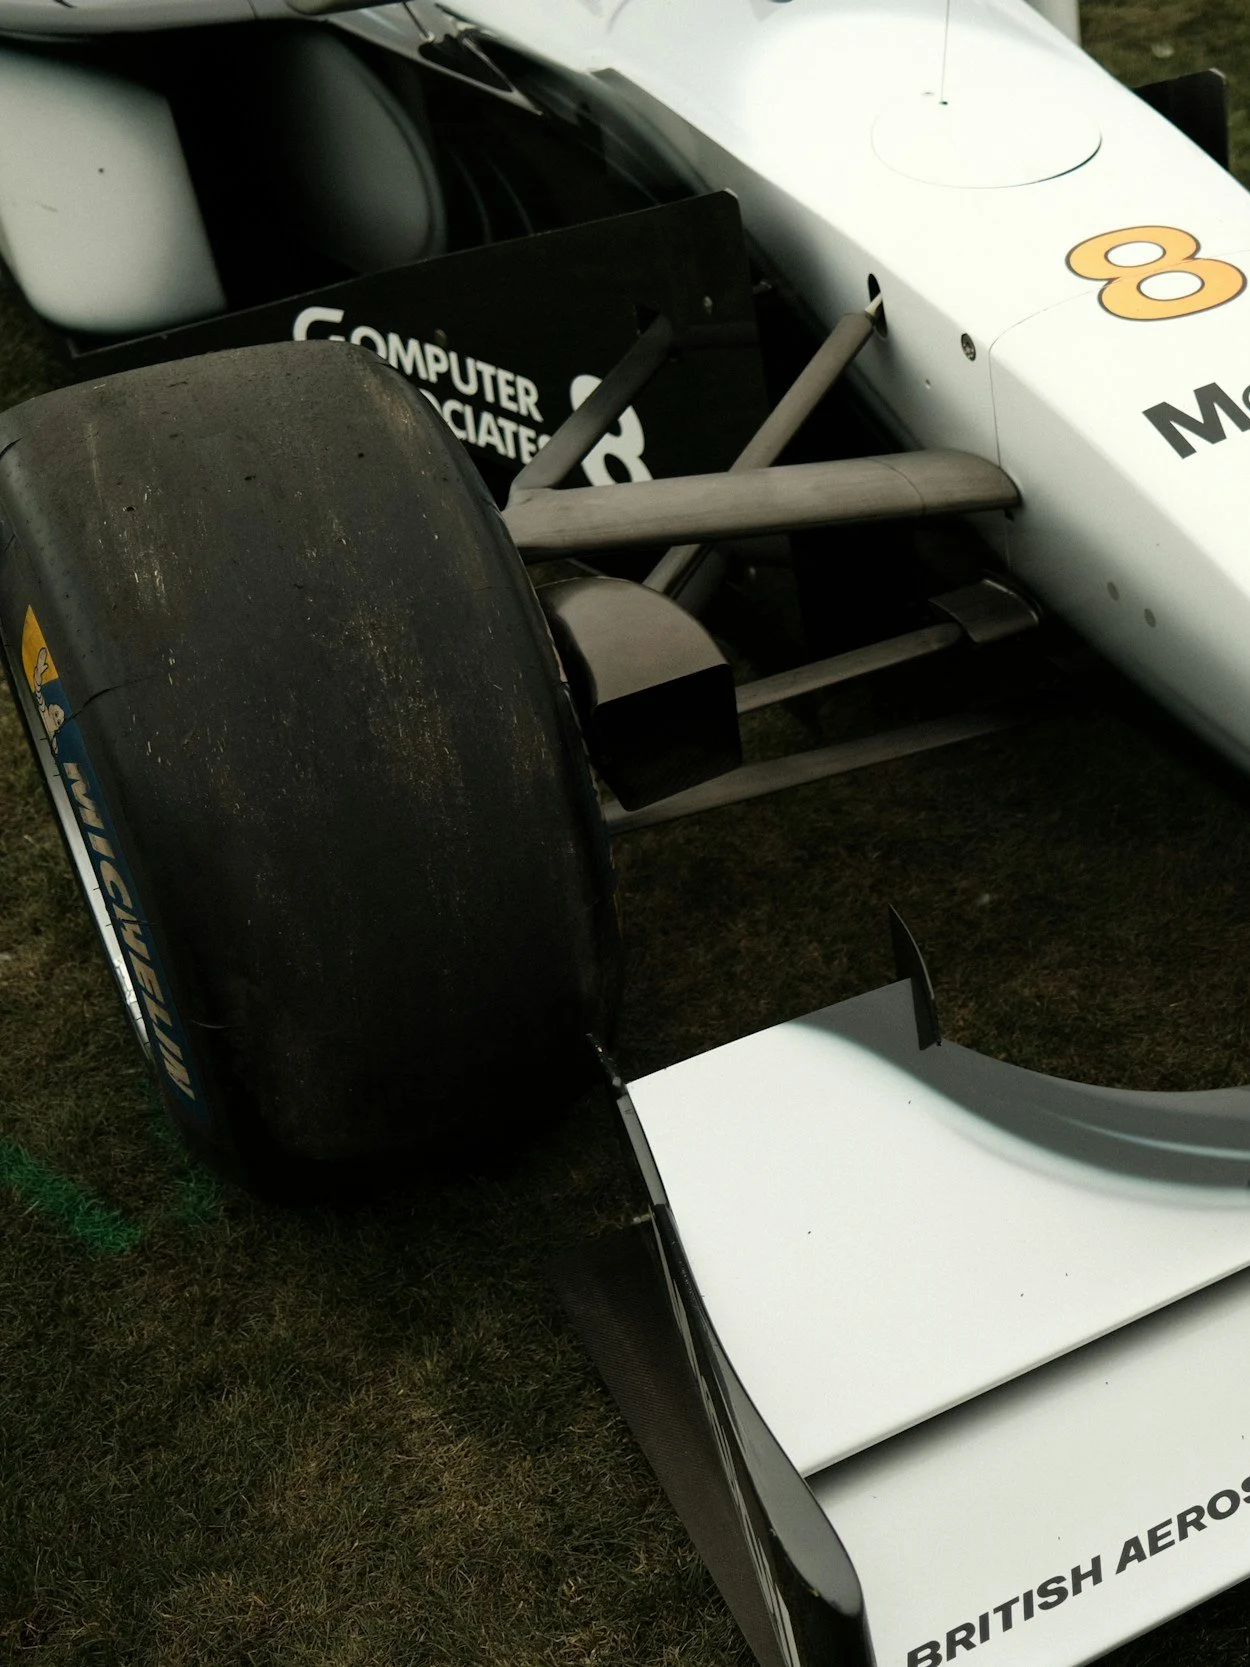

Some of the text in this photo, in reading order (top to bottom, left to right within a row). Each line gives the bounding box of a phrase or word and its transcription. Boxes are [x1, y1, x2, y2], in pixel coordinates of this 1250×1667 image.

[1065, 226, 1247, 321] 8
[63, 762, 196, 1100] MICHELIN
[907, 1554, 1102, 1667] BRITISH
